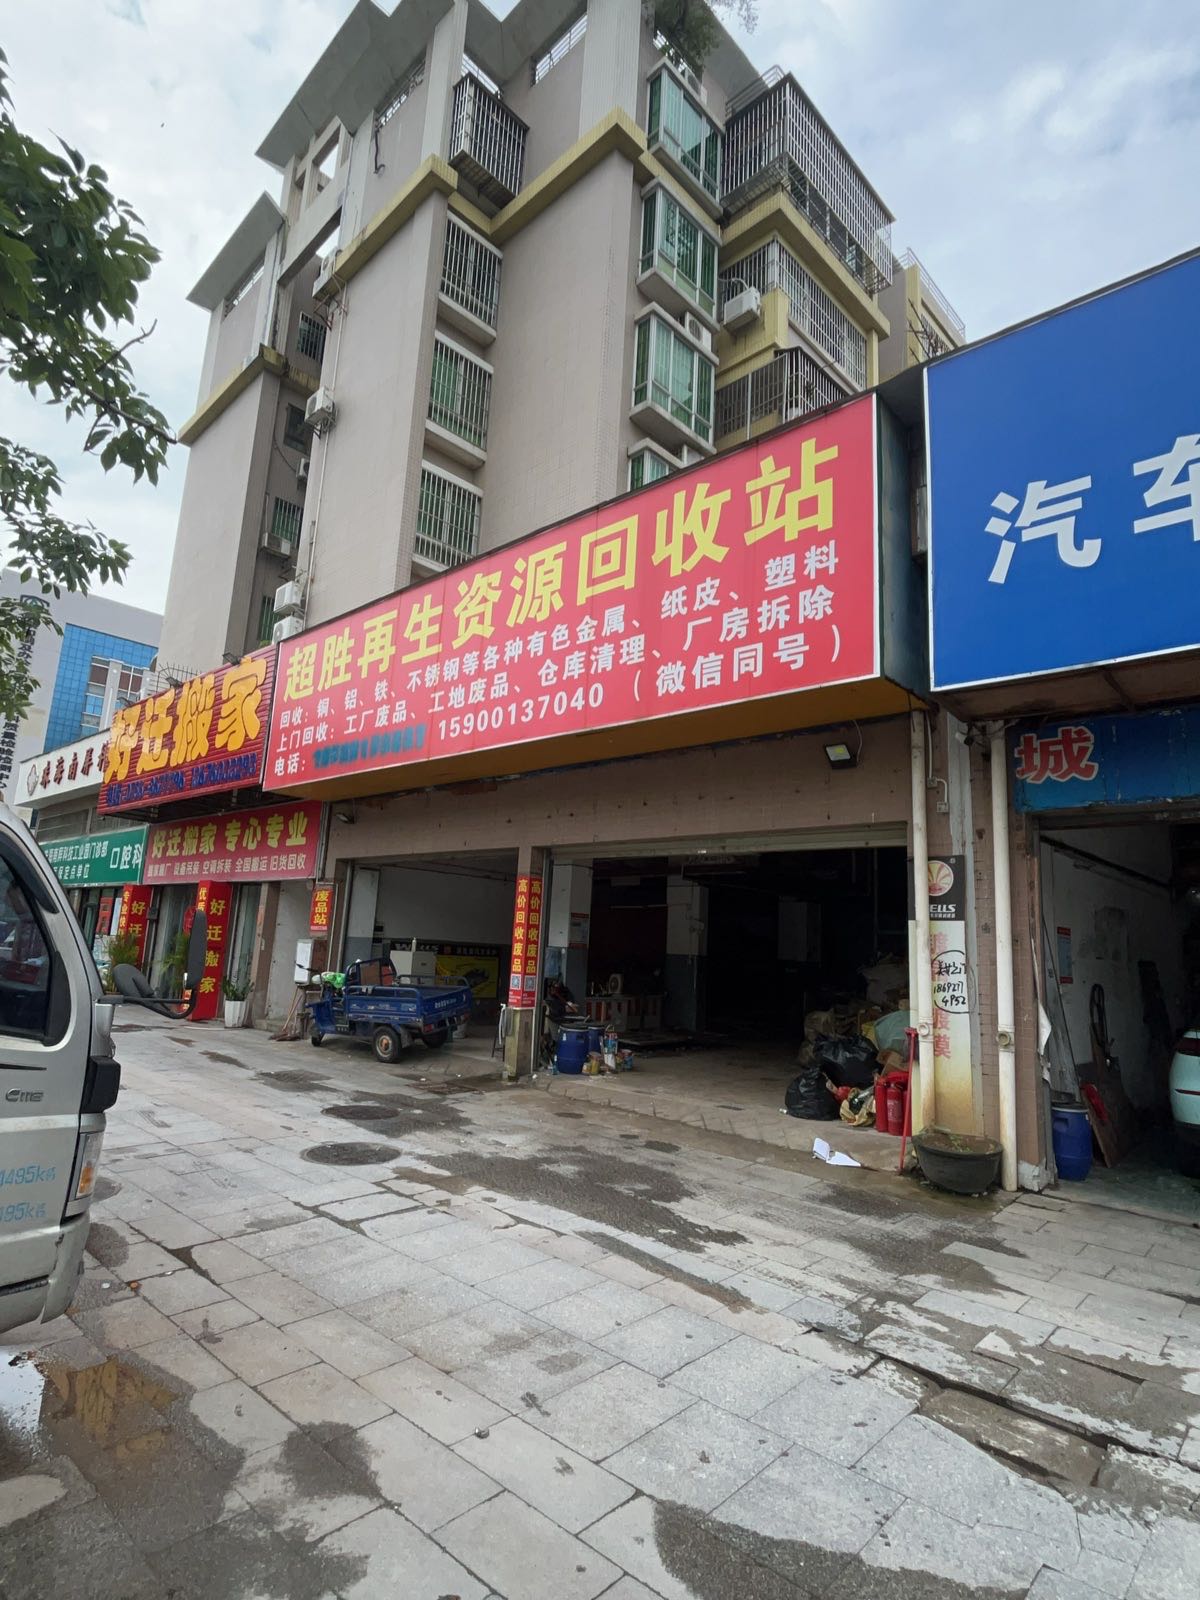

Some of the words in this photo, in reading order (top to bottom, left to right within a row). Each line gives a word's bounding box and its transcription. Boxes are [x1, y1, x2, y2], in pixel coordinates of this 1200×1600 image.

[984, 433, 1200, 584] 汽车
[283, 437, 840, 703] 超胜再生资源回收站
[105, 657, 267, 784] 好迁搬家
[437, 682, 604, 741] 15900137040
[1014, 725, 1099, 785] 城
[110, 842, 144, 869] 口腔科
[152, 823, 217, 858] 好迁搬家
[225, 811, 308, 852] 专心专业
[235, 856, 269, 873] 全国搬运
[269, 853, 307, 871] 旧货回收
[313, 890, 329, 926] 废品站
[512, 879, 527, 973] 高价回收废品
[526, 880, 542, 974] 高价回收废品
